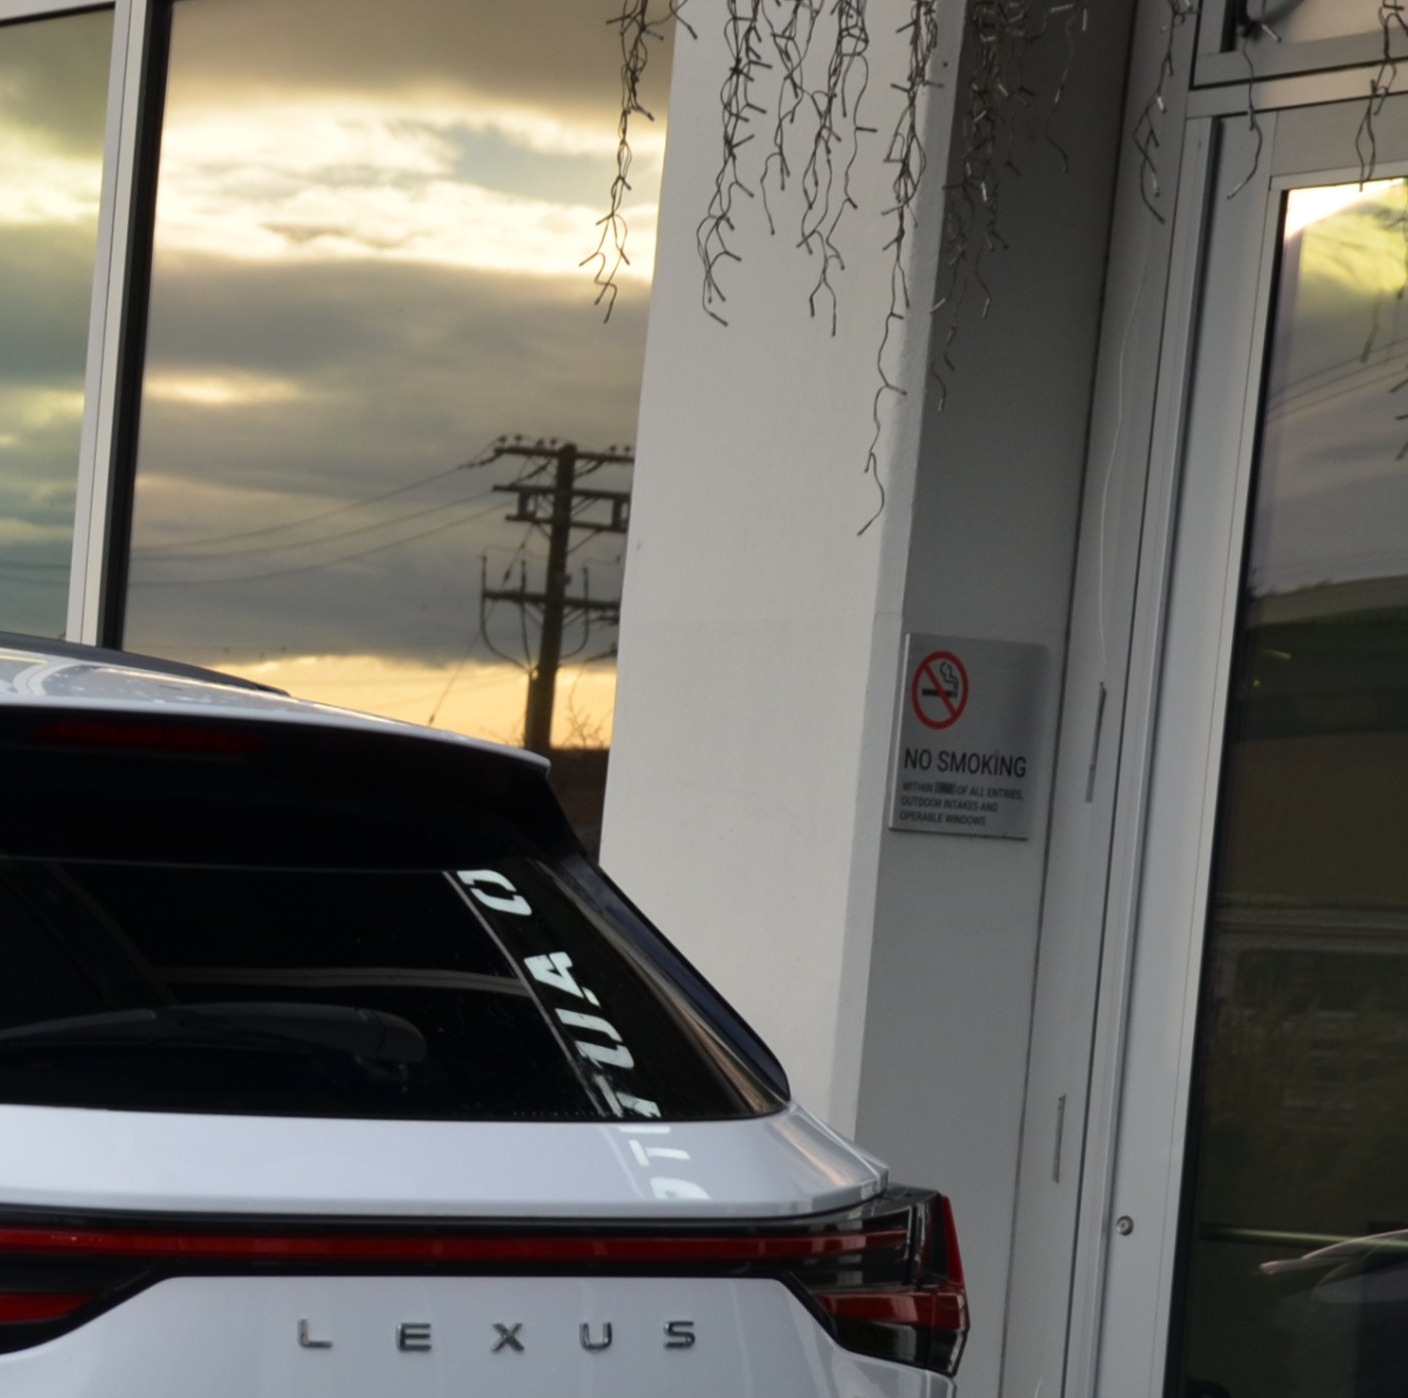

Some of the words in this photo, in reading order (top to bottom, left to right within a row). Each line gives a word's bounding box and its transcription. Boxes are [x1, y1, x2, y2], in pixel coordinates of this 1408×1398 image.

[904, 748, 933, 771] NO
[937, 750, 1028, 778] SMOKING
[902, 781, 934, 793] WITHIN
[957, 784, 969, 796] OF
[970, 786, 986, 798] ALL
[900, 796, 943, 809] OUTDOOR
[944, 799, 979, 811] INTAKES
[980, 802, 1000, 813] AND
[899, 810, 944, 824] OPERABLE
[297, 1317, 697, 1353] LEXUS
